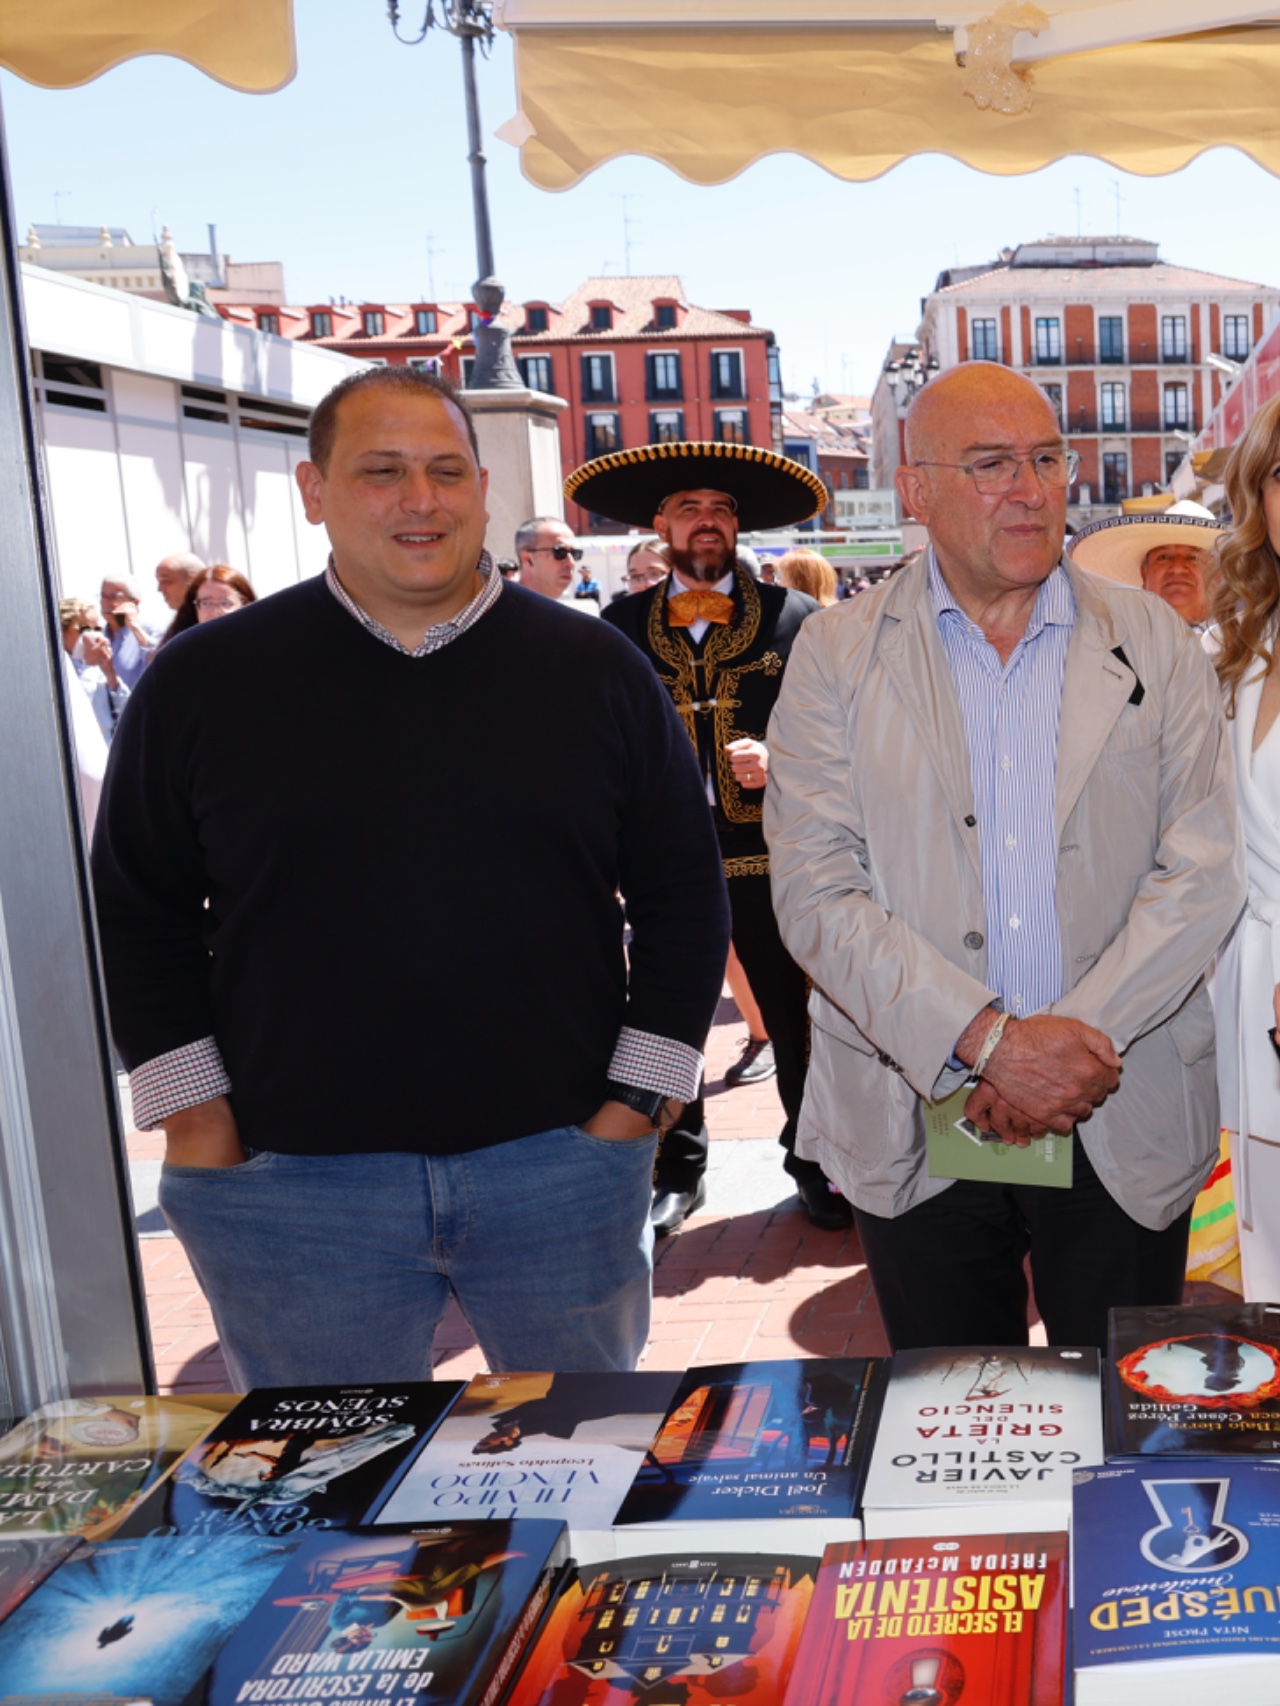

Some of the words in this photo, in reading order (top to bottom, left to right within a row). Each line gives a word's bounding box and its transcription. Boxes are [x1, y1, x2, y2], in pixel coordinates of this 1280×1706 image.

[918, 1404, 1063, 1417] SILENCIO
[1128, 1412, 1180, 1422] Pérez
[1129, 1404, 1198, 1412] Gellida
[1187, 1412, 1242, 1422] César
[250, 1413, 394, 1431] SOMBRA
[1168, 1422, 1222, 1430] tierra
[1228, 1421, 1270, 1430] Bajo
[916, 1424, 1062, 1439] GRIETA
[0, 1458, 152, 1478] CARTUJ
[891, 1451, 1081, 1468] CASTILLO
[430, 1471, 599, 1489] VENCIDO
[688, 1474, 740, 1484] salvaje
[744, 1472, 799, 1482] animal
[804, 1472, 827, 1481] Un
[915, 1468, 1054, 1484] JAVIER
[0, 1488, 99, 1507] DAM
[433, 1488, 572, 1506] TIEMPO
[711, 1486, 780, 1497] Dicker
[787, 1483, 827, 1496] Joël
[0, 1510, 46, 1525] LA
[839, 1556, 959, 1578] McFADDEN
[970, 1552, 1048, 1570] FREIDA
[834, 1574, 1046, 1619] ASISTENTA
[847, 1618, 873, 1640] LA
[875, 1616, 903, 1638] DE
[907, 1612, 998, 1636] SECRETO
[1003, 1611, 1023, 1633] EL
[271, 1652, 342, 1675] WARD
[350, 1647, 431, 1671] EMILIA
[235, 1673, 373, 1703] ESCRITORA
[375, 1673, 401, 1695] la
[403, 1672, 434, 1693] de
